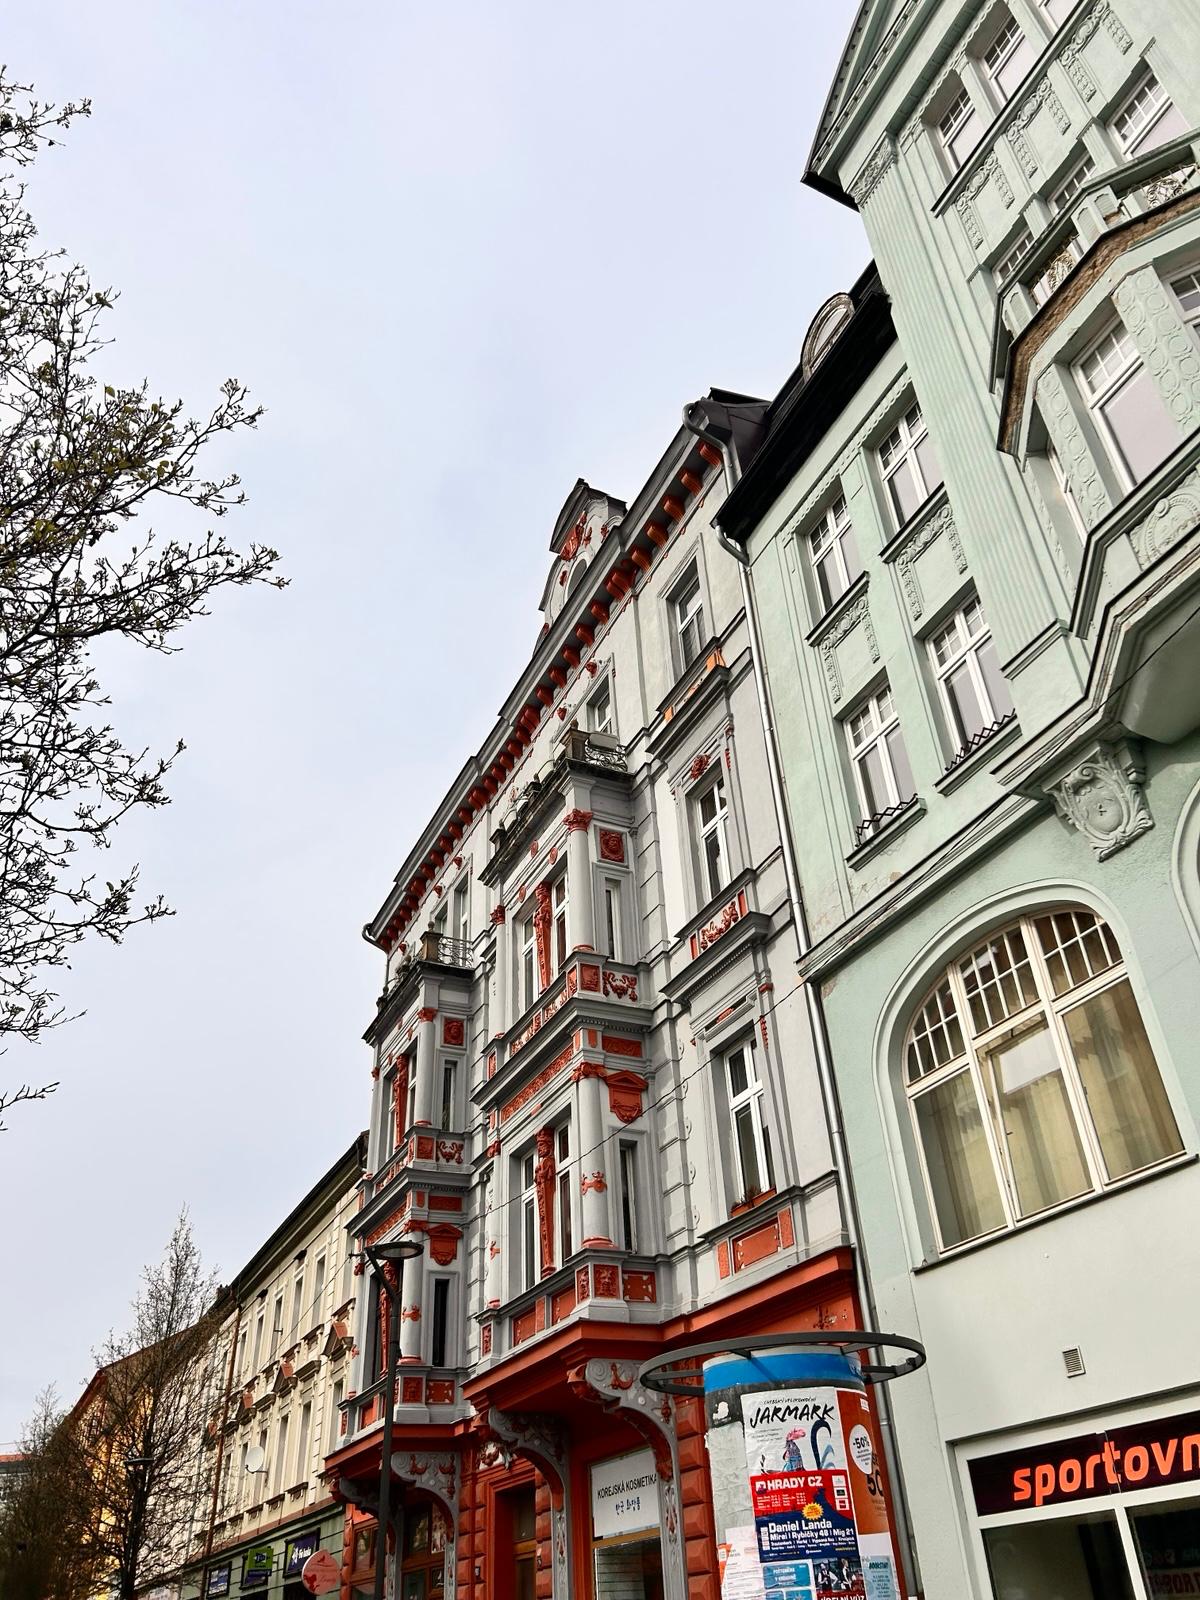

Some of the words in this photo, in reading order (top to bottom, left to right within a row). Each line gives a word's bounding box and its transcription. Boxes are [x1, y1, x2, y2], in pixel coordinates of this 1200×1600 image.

[750, 1404, 835, 1428] JARMARK
[853, 1435, 870, 1449] -50%
[1013, 1433, 1200, 1507] sportovn
[597, 1480, 625, 1500] KOREJSKÁ
[625, 1473, 657, 1492] KOSMETIKA
[767, 1477, 805, 1491] HRADY
[808, 1476, 824, 1487] CZ
[768, 1520, 799, 1533] Daniel
[801, 1519, 832, 1530] Landa
[792, 1530, 818, 1540] Rybičky
[819, 1529, 829, 1537] 48
[833, 1528, 845, 1536] Mig
